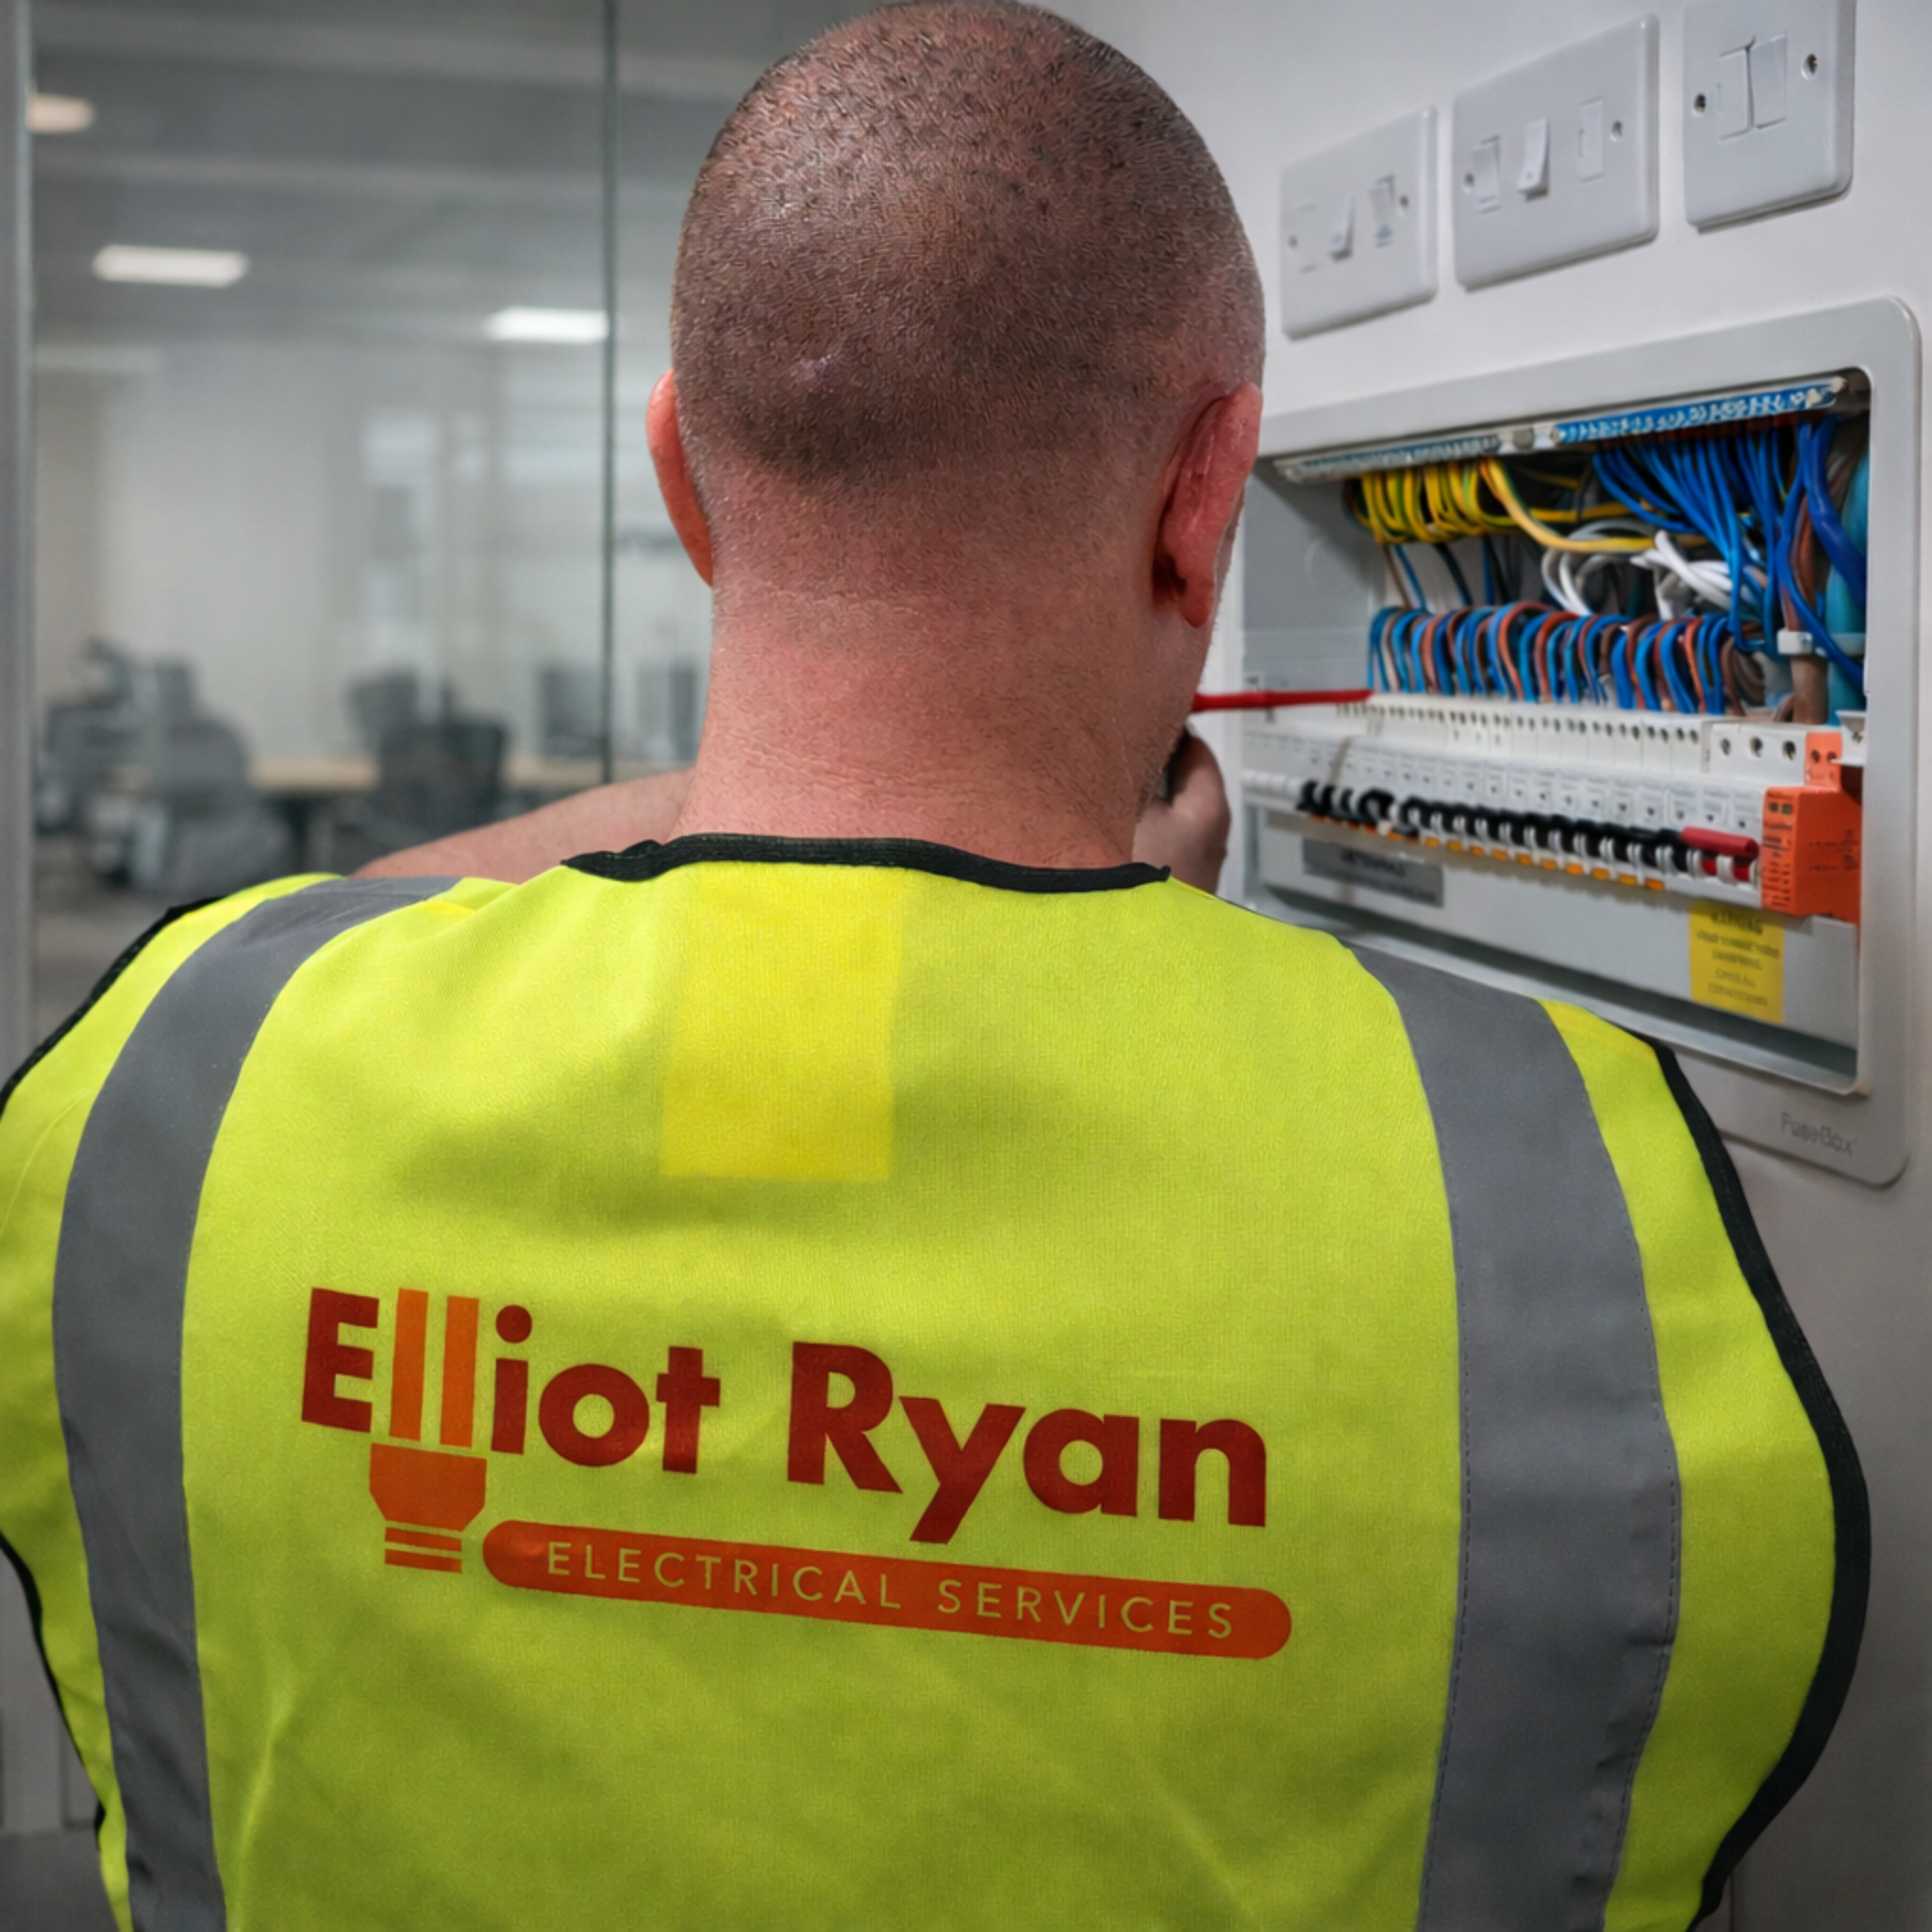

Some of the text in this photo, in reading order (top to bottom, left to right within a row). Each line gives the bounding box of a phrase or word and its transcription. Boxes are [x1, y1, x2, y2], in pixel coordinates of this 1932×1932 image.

[302, 1289, 1267, 1544] Elliot Ryan
[546, 1541, 1234, 1640] ELECTRICAL SERVICES
